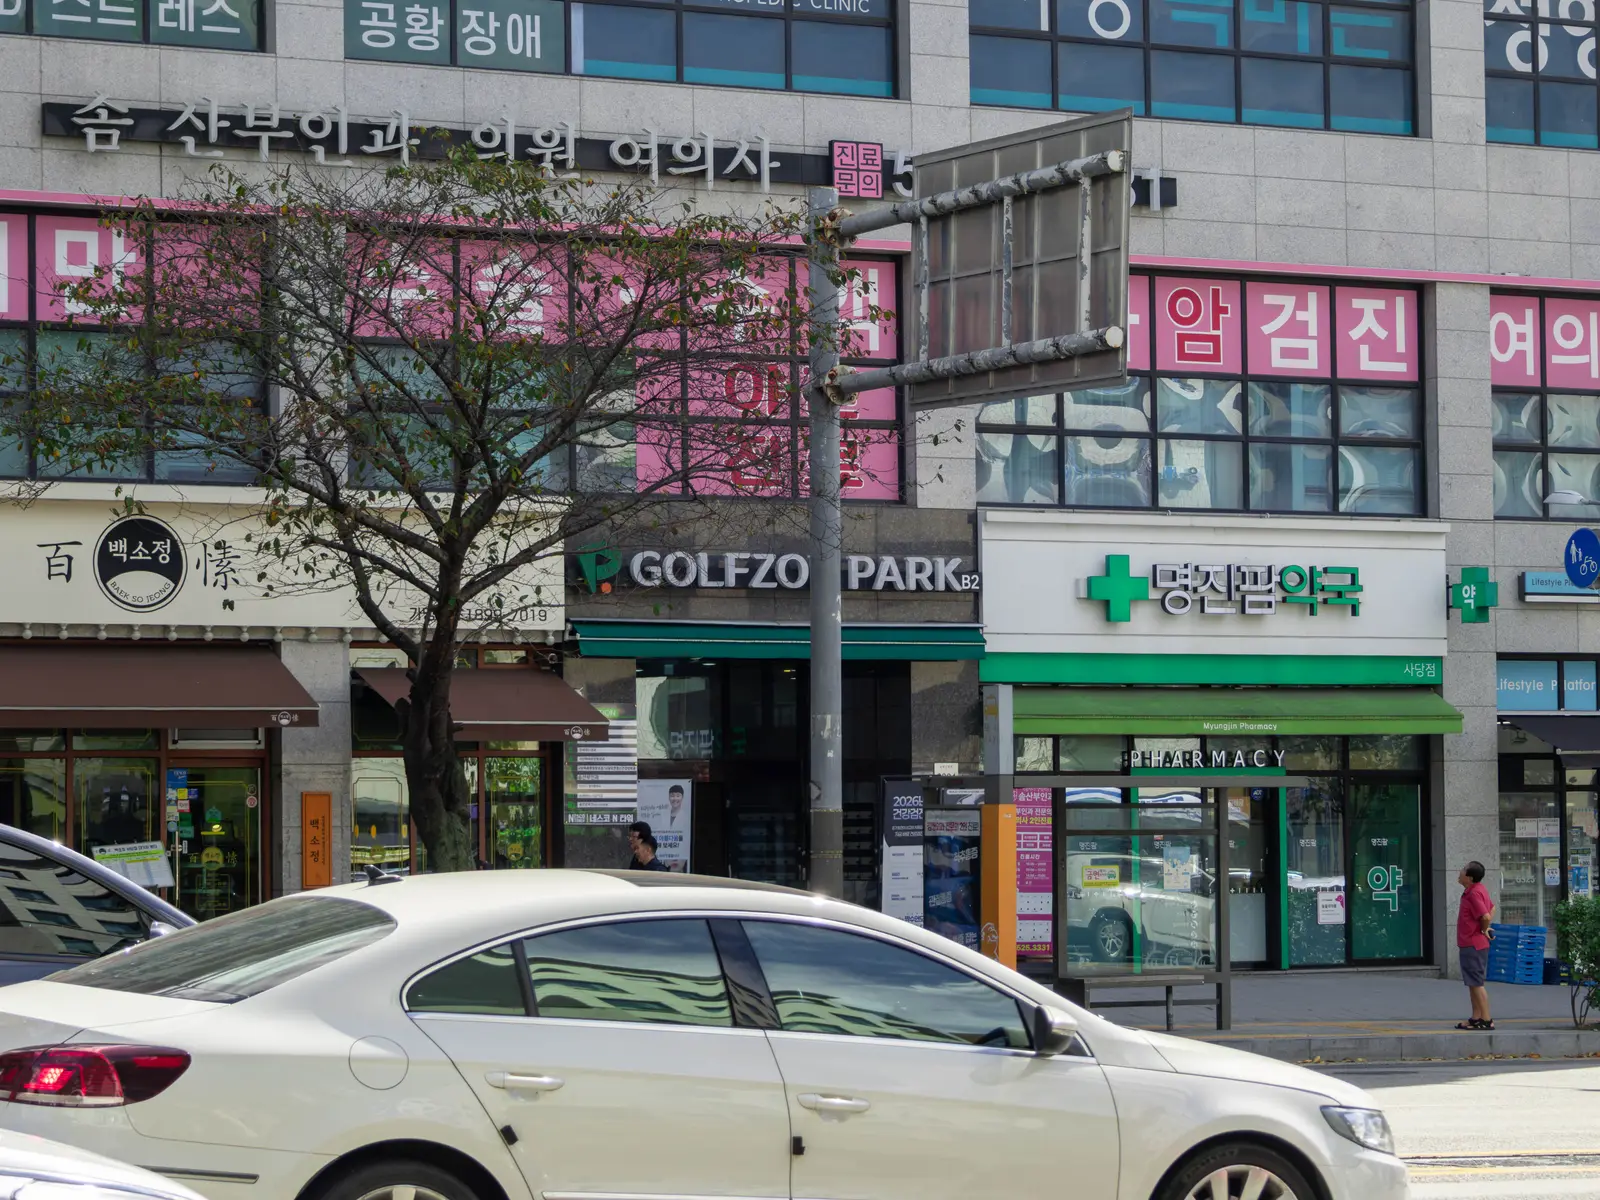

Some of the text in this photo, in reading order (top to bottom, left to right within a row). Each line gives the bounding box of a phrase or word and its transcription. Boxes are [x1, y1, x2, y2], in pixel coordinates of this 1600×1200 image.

[70, 92, 135, 153] 솜
[167, 96, 421, 168] 산부인과
[609, 126, 782, 195] 여의사
[836, 145, 881, 169] 진료
[835, 171, 881, 197] 문의
[108, 537, 171, 564] 백소정
[630, 550, 980, 592] GOLFZO PARK B2
[1531, 578, 1562, 588] Lifestyle
[110, 581, 171, 603] BAEK SO JEONG
[1462, 585, 1476, 609] 약
[1403, 662, 1436, 678] 사당점
[1497, 678, 1544, 694] ifestyle
[1203, 720, 1278, 732] Myungjin Pharmacy
[1131, 750, 1286, 768] PHARMACY
[309, 818, 320, 863] 백소정
[1367, 865, 1403, 911] 약
